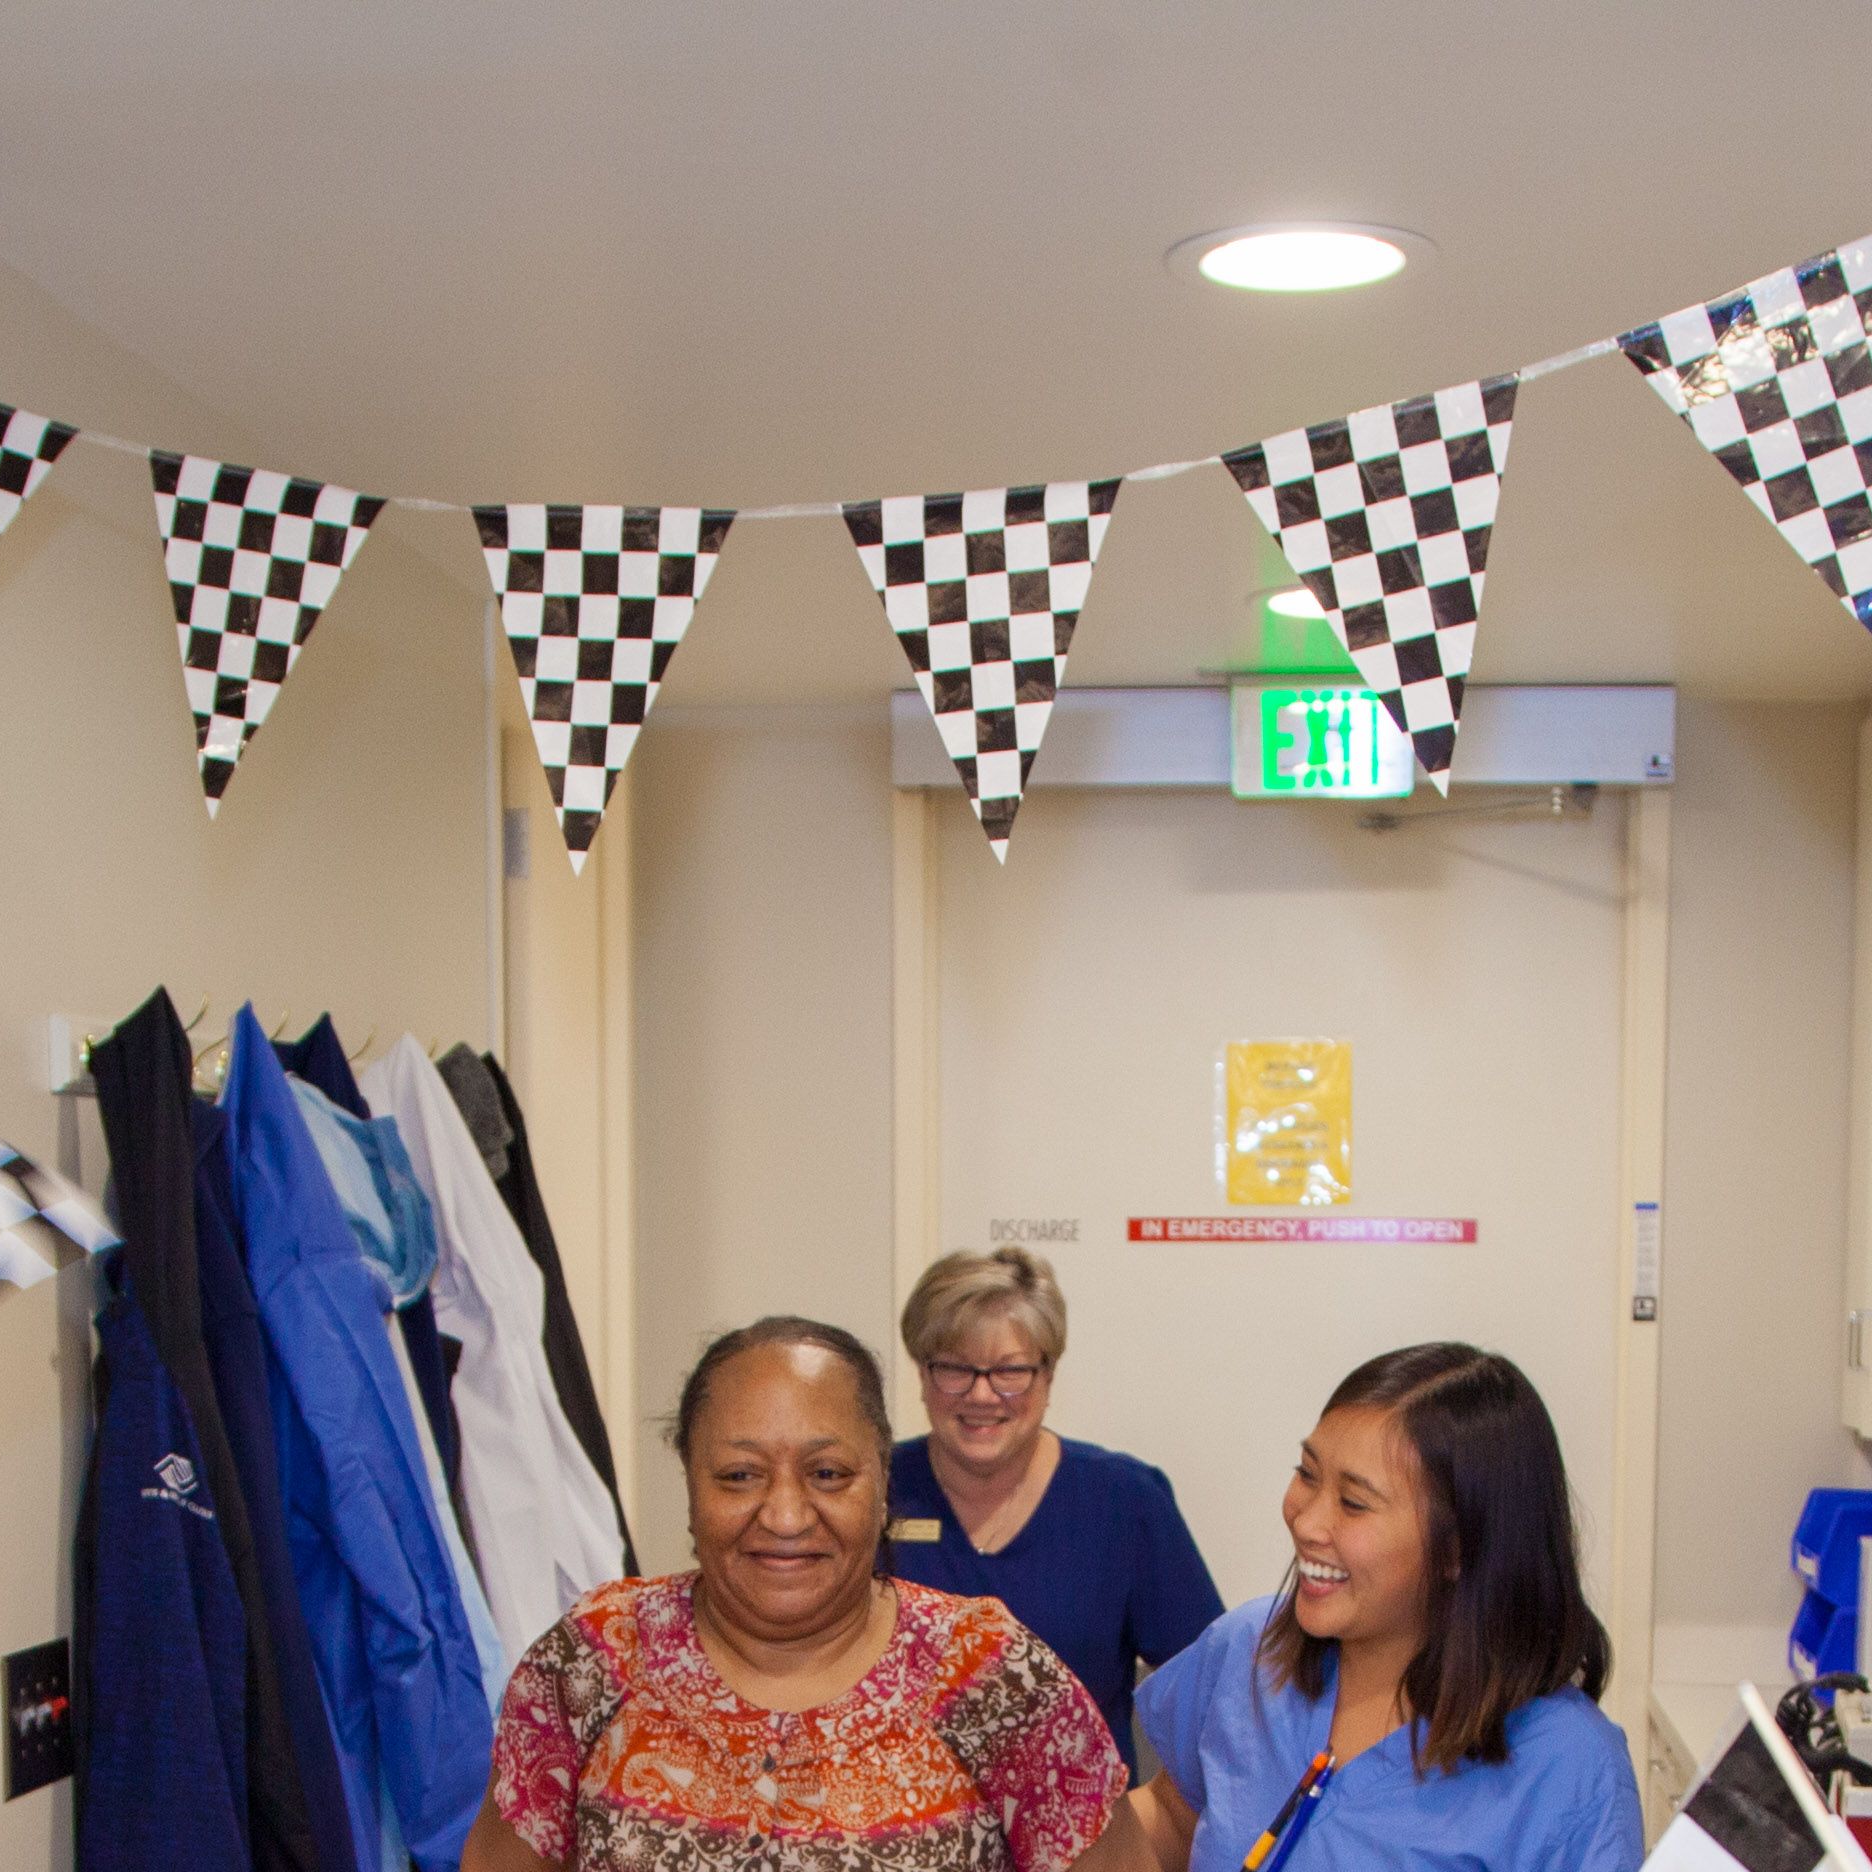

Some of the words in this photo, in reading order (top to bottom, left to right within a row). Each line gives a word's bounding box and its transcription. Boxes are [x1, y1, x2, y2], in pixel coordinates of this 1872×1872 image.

[1261, 689, 1380, 789] EXIT
[990, 1218, 1080, 1241] DISCHARGE
[1141, 1221, 1163, 1238] IN
[1168, 1220, 1303, 1239] EMERGENCY,
[1308, 1220, 1366, 1239] PUSH
[1371, 1220, 1399, 1239] TO
[1404, 1221, 1464, 1239] OPEN
